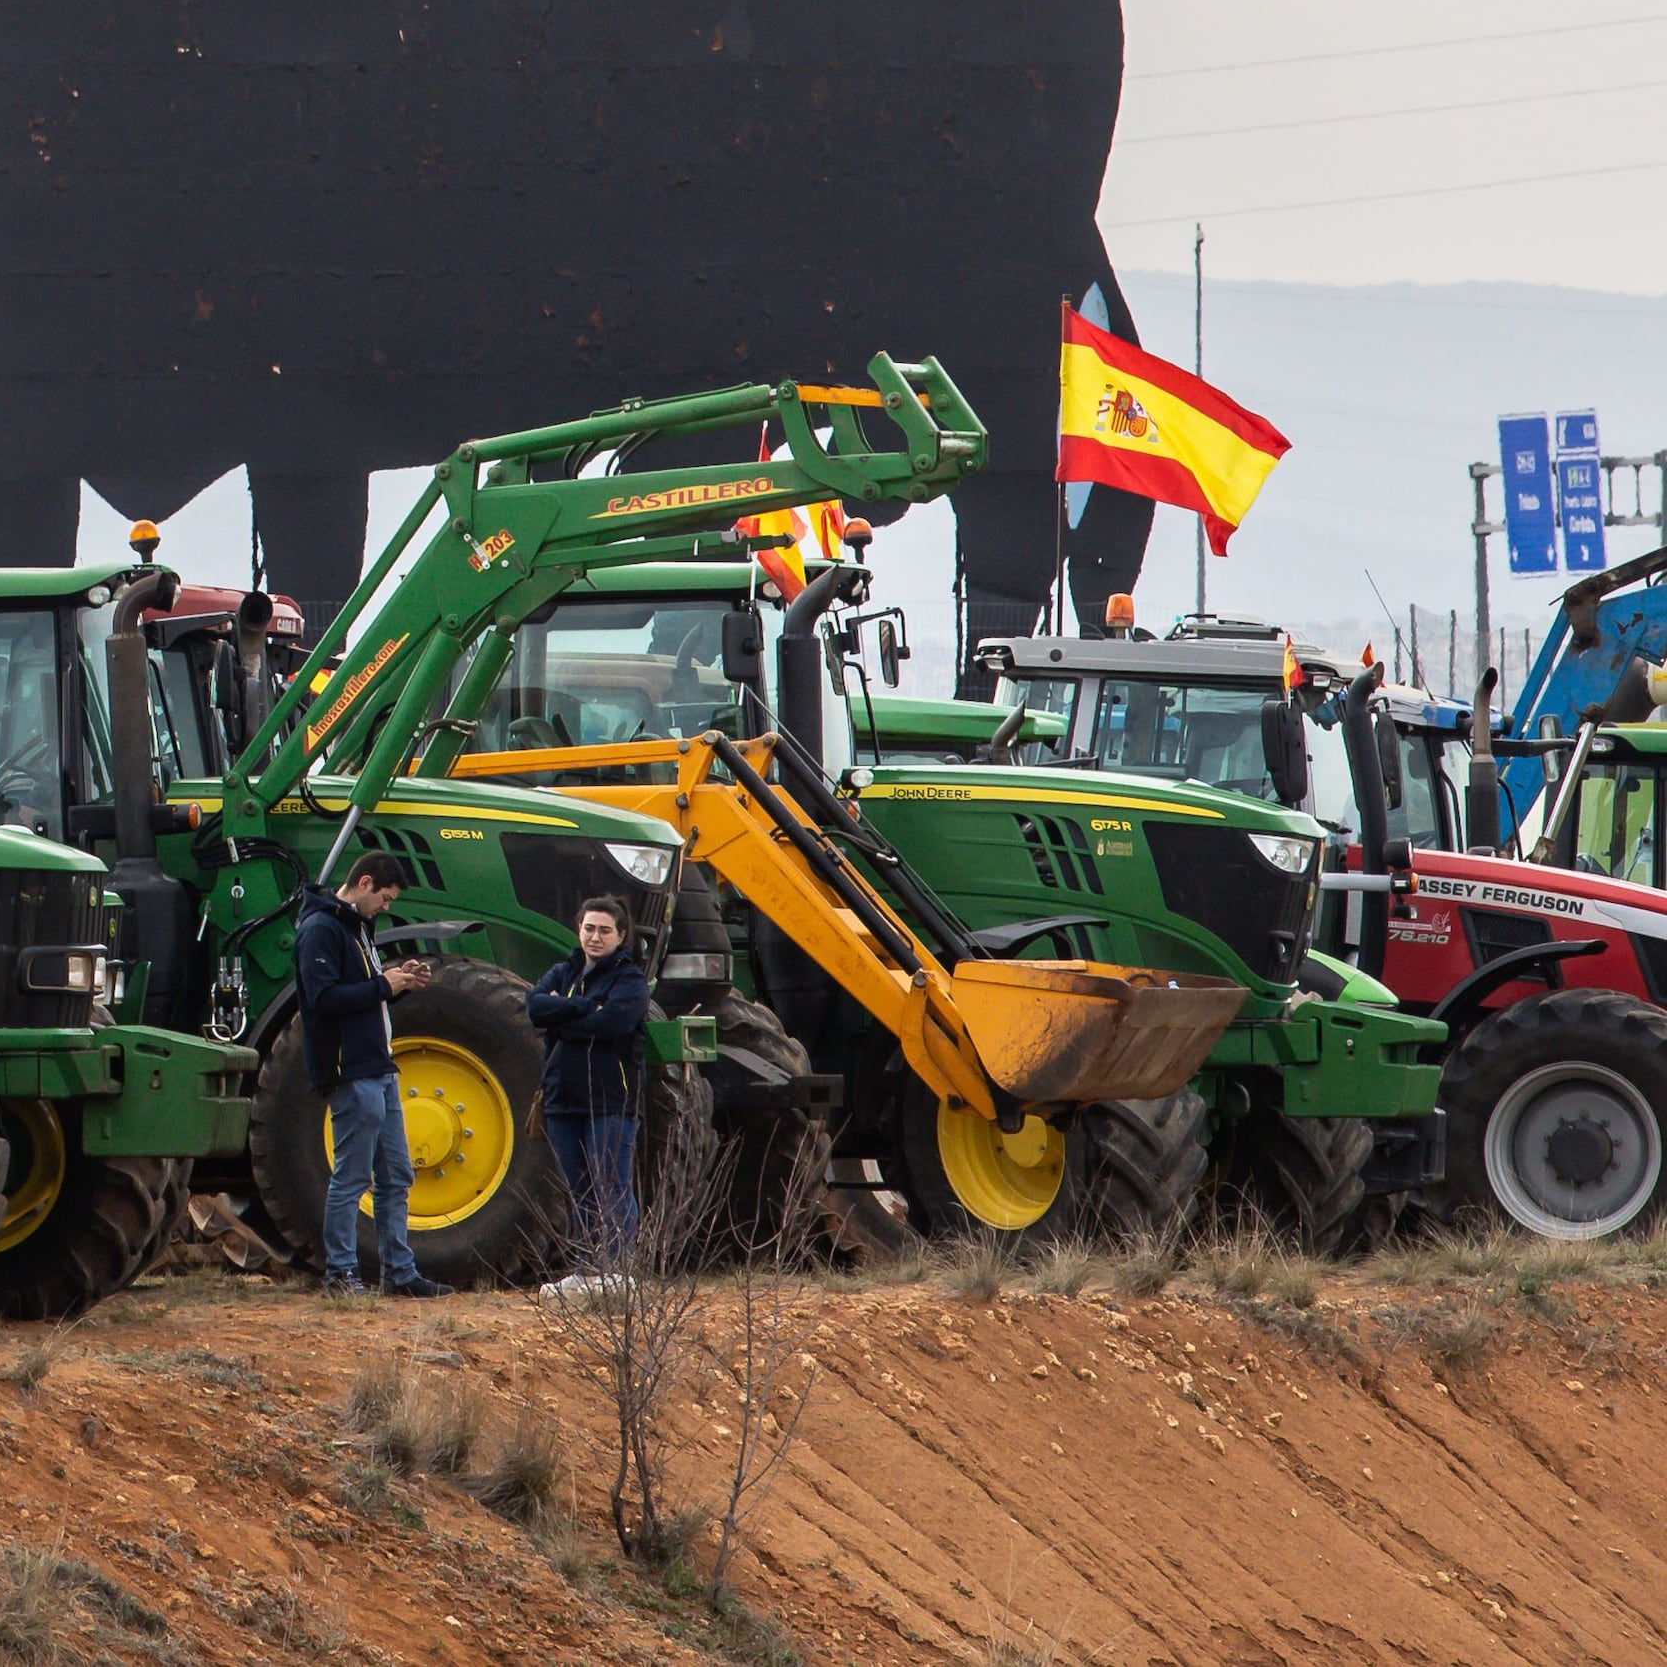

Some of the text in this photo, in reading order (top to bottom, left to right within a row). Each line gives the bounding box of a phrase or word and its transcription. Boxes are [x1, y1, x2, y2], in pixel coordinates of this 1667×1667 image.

[607, 477, 774, 514] CASTILLERO
[485, 529, 513, 558] 203
[889, 786, 972, 799] JOHN DEERE
[271, 802, 308, 813] EERE
[1090, 819, 1133, 832] 6175 R
[440, 829, 484, 840] 6155 M
[1418, 879, 1585, 916] ASSEY FERGUSON
